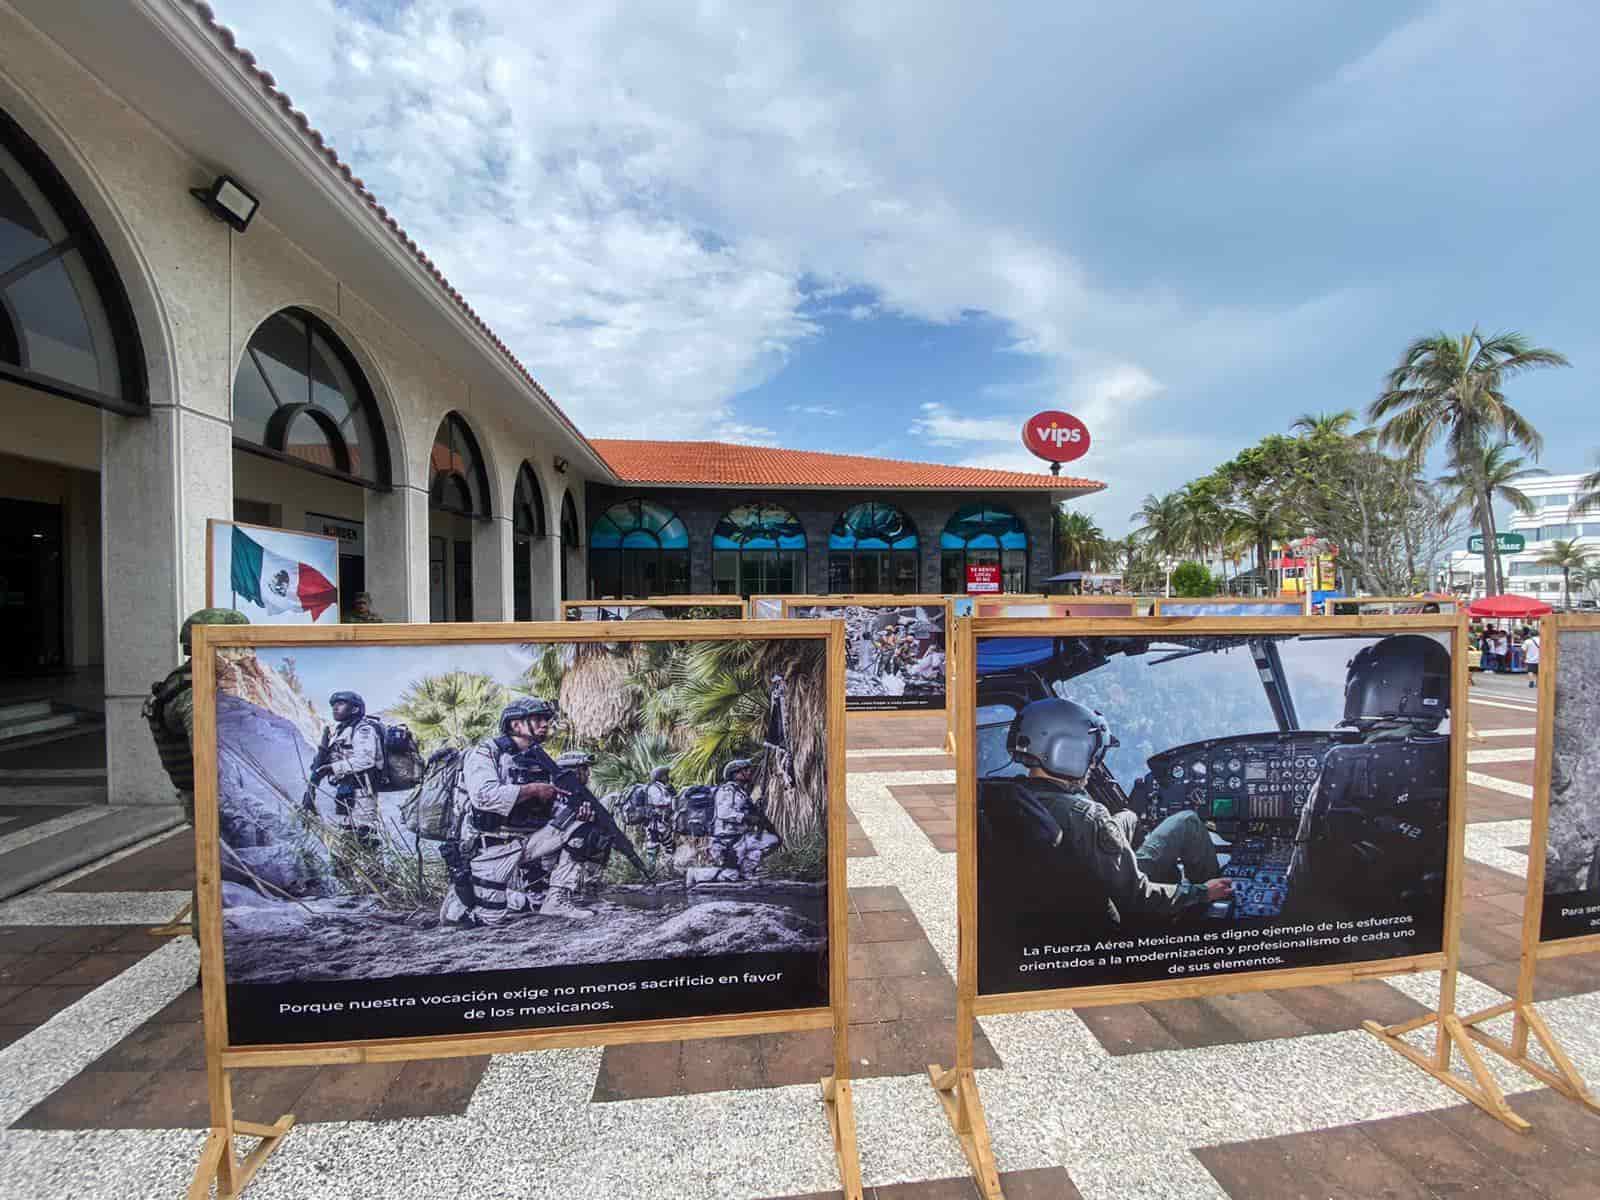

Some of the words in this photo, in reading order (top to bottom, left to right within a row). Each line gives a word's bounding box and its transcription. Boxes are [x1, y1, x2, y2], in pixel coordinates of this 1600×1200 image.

[1036, 422, 1081, 448] vips
[1019, 957, 1095, 972] orientados
[1098, 958, 1106, 966] a
[1110, 954, 1122, 965] la
[1125, 945, 1224, 963] modernización
[1226, 944, 1235, 955] y
[1238, 935, 1341, 954] profesionalismo
[1342, 934, 1359, 944] de
[1361, 930, 1390, 942] cada
[1392, 928, 1416, 938] uno
[1023, 946, 1040, 957] La
[1044, 943, 1091, 955] Fuerza
[1094, 938, 1134, 951] Aérea
[1138, 934, 1200, 947] Mexicana
[1203, 932, 1219, 941] es
[1221, 926, 1260, 941] digno
[1262, 922, 1315, 937] ejemplo
[1317, 921, 1334, 932] de
[1336, 920, 1354, 930] los
[1356, 914, 1414, 928] esfuerzos
[1167, 964, 1185, 974] de
[1188, 962, 1211, 973] sus
[1213, 956, 1286, 970] elementos.
[279, 1001, 344, 1014] Porque
[350, 997, 416, 1009] nuestra
[421, 990, 498, 1005] vocación
[503, 986, 549, 1000] exige
[554, 986, 575, 996] no
[580, 981, 637, 995] menos
[641, 975, 714, 990] sacrificio
[718, 973, 739, 984] en
[743, 972, 783, 983] favor
[463, 1008, 486, 1020] de
[490, 1006, 515, 1018] los
[519, 999, 614, 1016] mexicanos.
